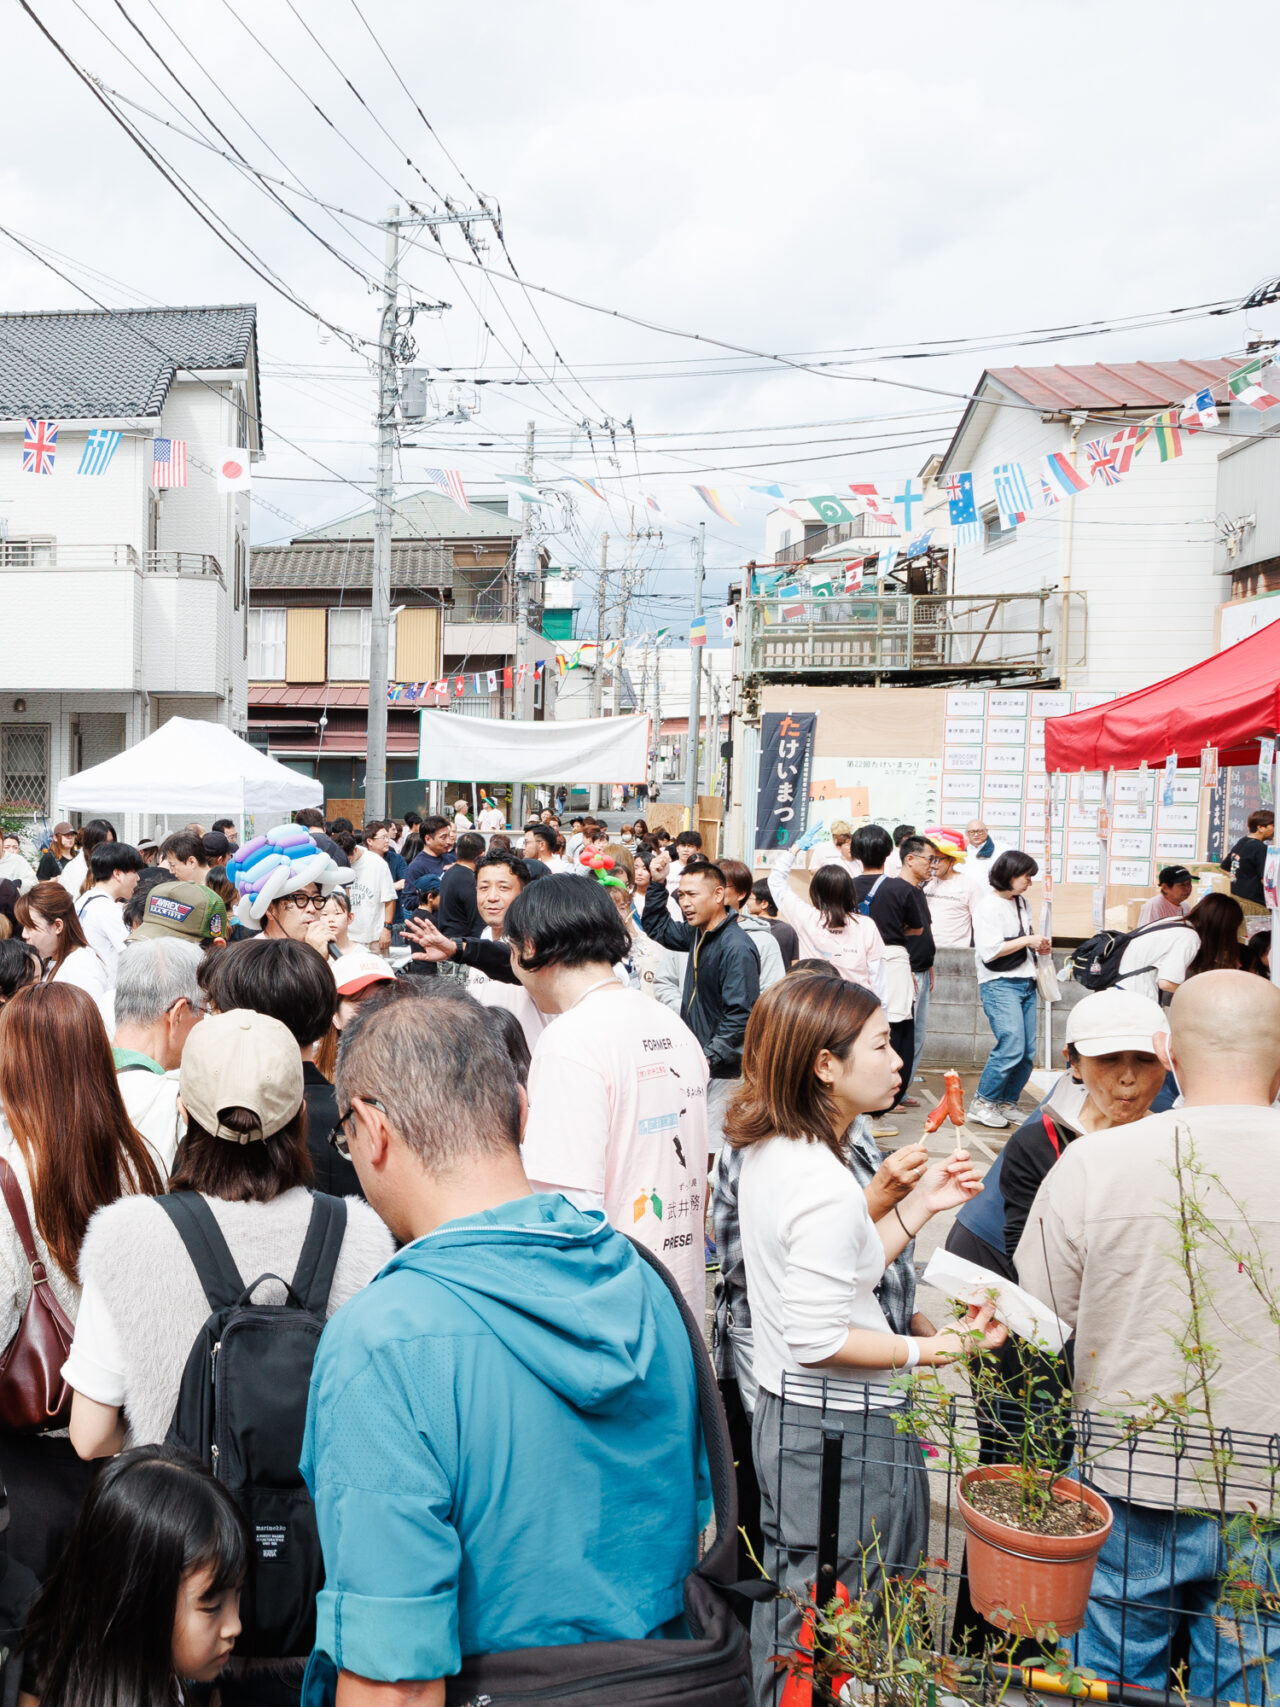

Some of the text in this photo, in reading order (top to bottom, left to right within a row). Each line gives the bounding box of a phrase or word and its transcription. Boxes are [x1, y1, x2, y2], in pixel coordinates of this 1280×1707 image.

[773, 716, 800, 846] たけいまつり
[642, 1038, 673, 1052] FORMER
